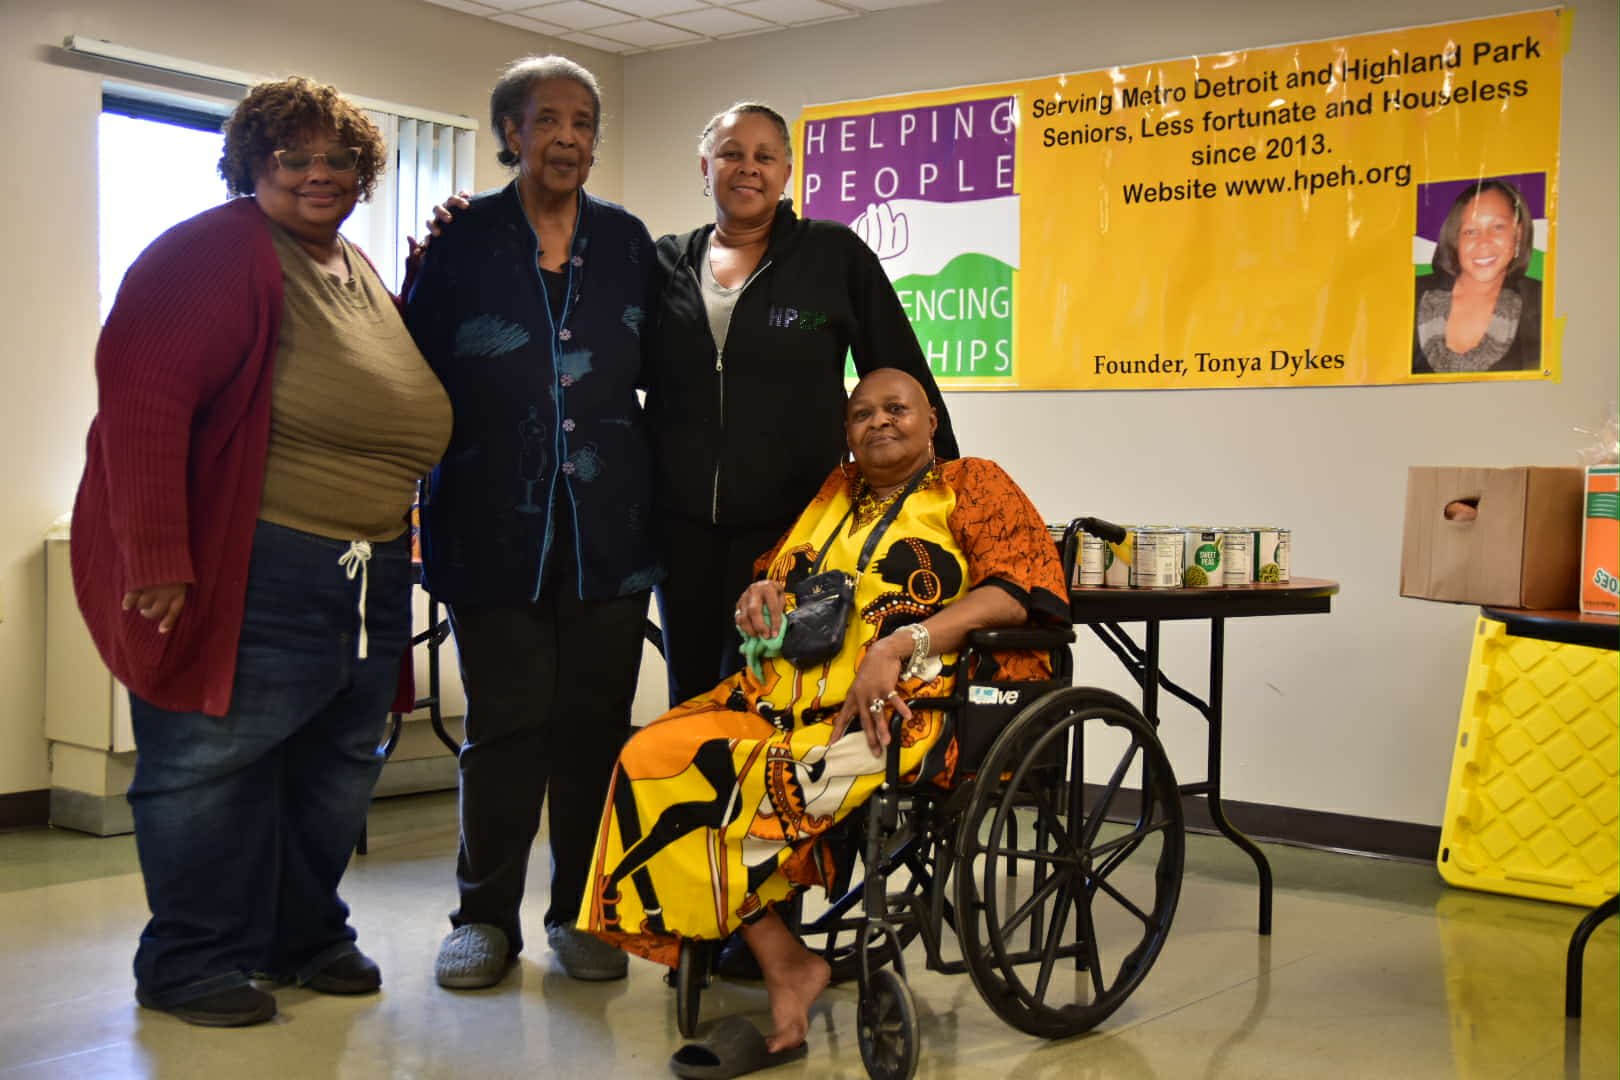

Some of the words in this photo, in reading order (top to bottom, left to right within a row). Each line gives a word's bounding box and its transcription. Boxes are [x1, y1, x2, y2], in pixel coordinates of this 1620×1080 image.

[1032, 92, 1113, 119] Serving
[1121, 84, 1186, 109] Metro
[1193, 71, 1277, 99] Detroit
[1285, 64, 1333, 89] and
[1343, 45, 1462, 84] Highland
[1473, 35, 1541, 66] Park
[806, 102, 1013, 155] HELPING
[1043, 124, 1133, 148] Seniors,
[1141, 117, 1194, 138] Less
[1202, 97, 1316, 132] fortunate
[1325, 91, 1372, 119] and
[1383, 78, 1529, 112] Houseless
[1192, 144, 1256, 166] since
[1266, 133, 1333, 160] 2013.
[805, 154, 1012, 205] PEOPLE
[1122, 179, 1217, 205] Website
[1225, 163, 1412, 197] www.hpeh.org
[1094, 354, 1188, 377] Founder,
[1194, 352, 1261, 378] Tonya
[1270, 348, 1345, 377] Dykes
